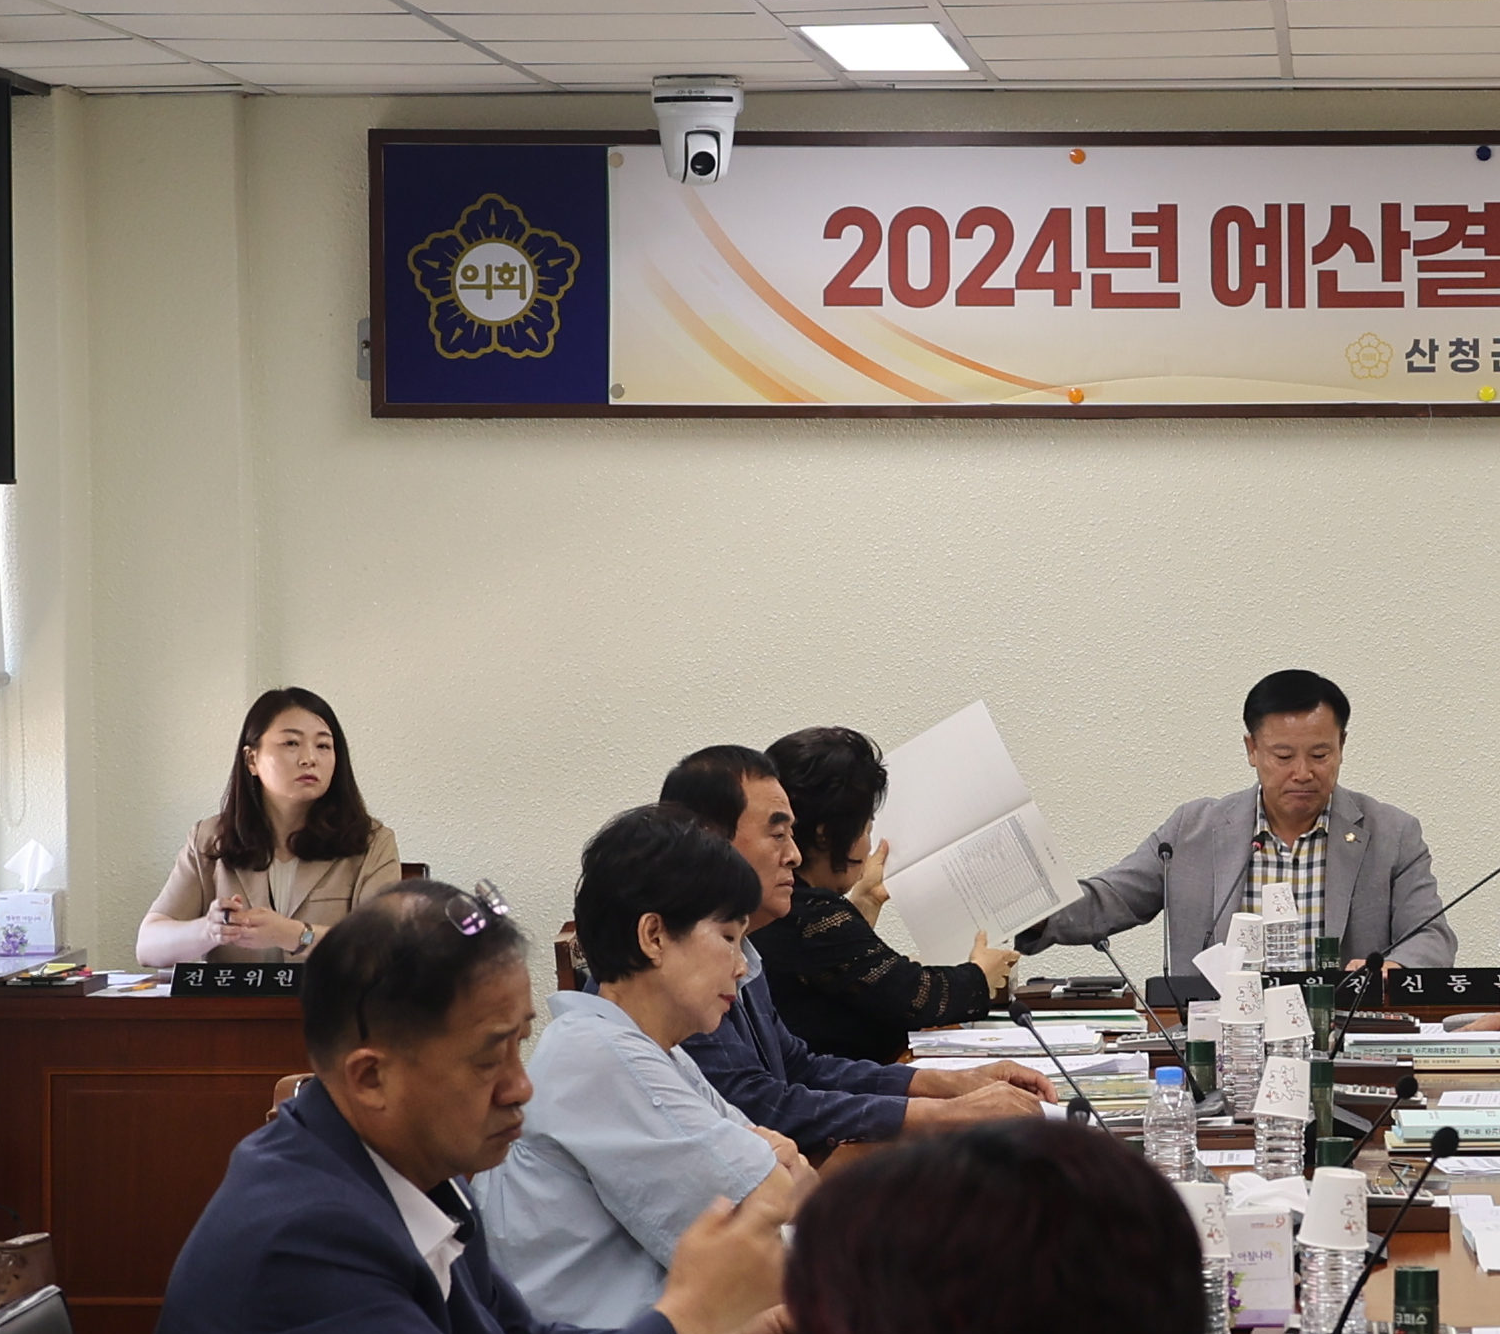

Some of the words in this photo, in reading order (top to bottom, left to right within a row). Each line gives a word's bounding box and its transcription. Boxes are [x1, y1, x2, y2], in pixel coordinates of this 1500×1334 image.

[823, 204, 1182, 311] 2024년
[458, 261, 527, 301] 의회
[183, 968, 294, 988] 전문위원
[1237, 1250, 1274, 1262] 아침나라
